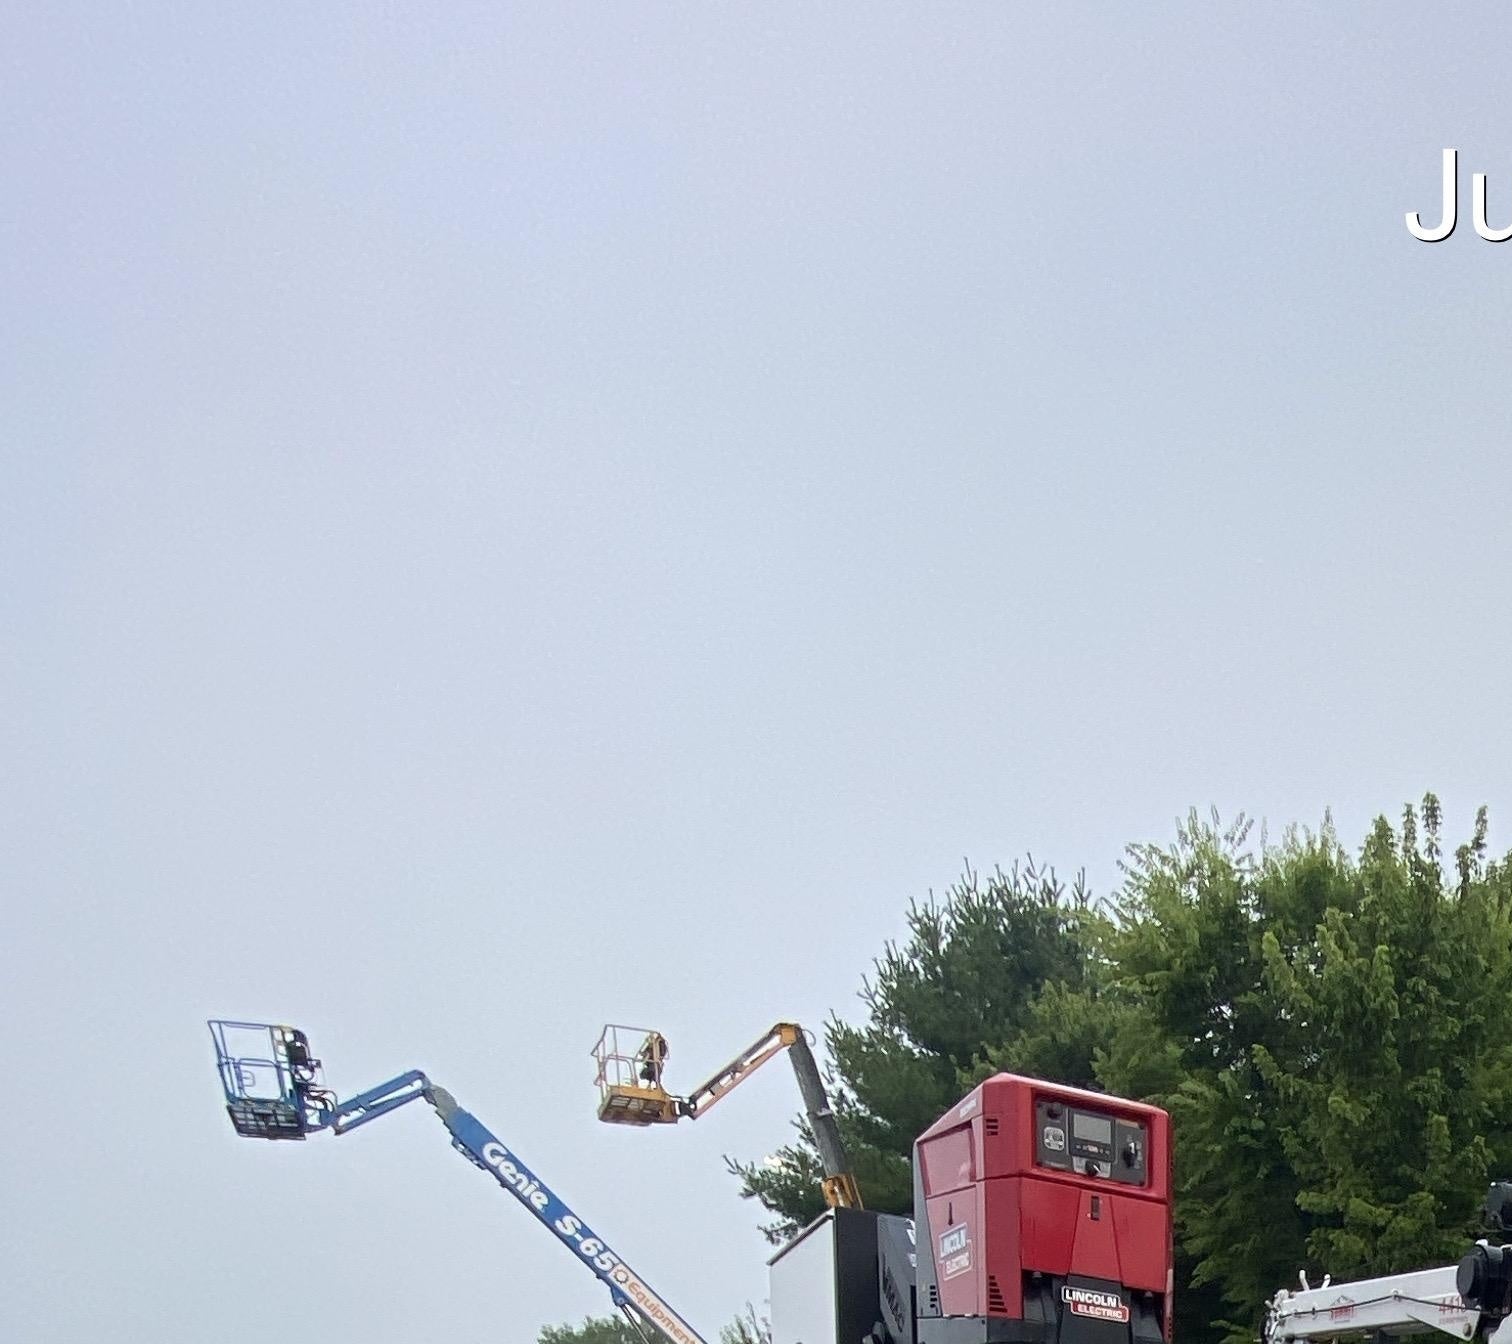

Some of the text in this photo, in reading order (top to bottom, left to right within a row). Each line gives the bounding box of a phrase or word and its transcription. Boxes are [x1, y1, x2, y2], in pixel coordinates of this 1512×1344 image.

[483, 1141, 619, 1272] Genie S-65
[1065, 1289, 1117, 1308] LINCOLN
[1077, 1303, 1123, 1319] ELECTRIC
